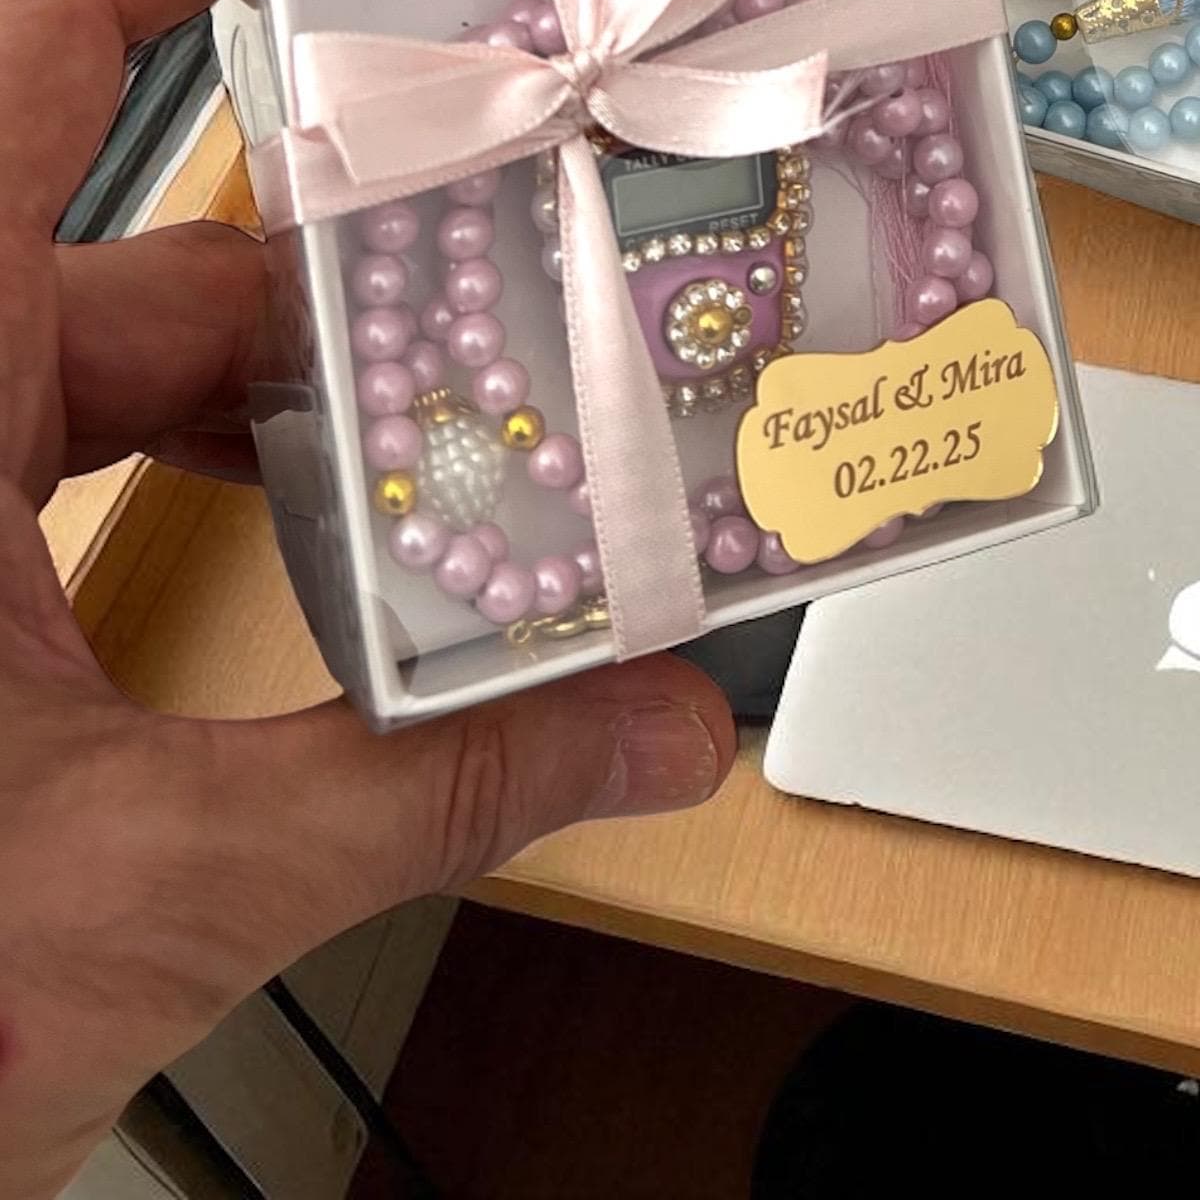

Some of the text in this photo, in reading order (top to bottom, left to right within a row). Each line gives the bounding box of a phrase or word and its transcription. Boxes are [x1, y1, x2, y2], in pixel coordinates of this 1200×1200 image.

[624, 153, 668, 171] TALLY
[709, 212, 758, 232] RESET
[763, 349, 1026, 450] Faysal & Mira
[833, 421, 983, 499] 02.22.25
